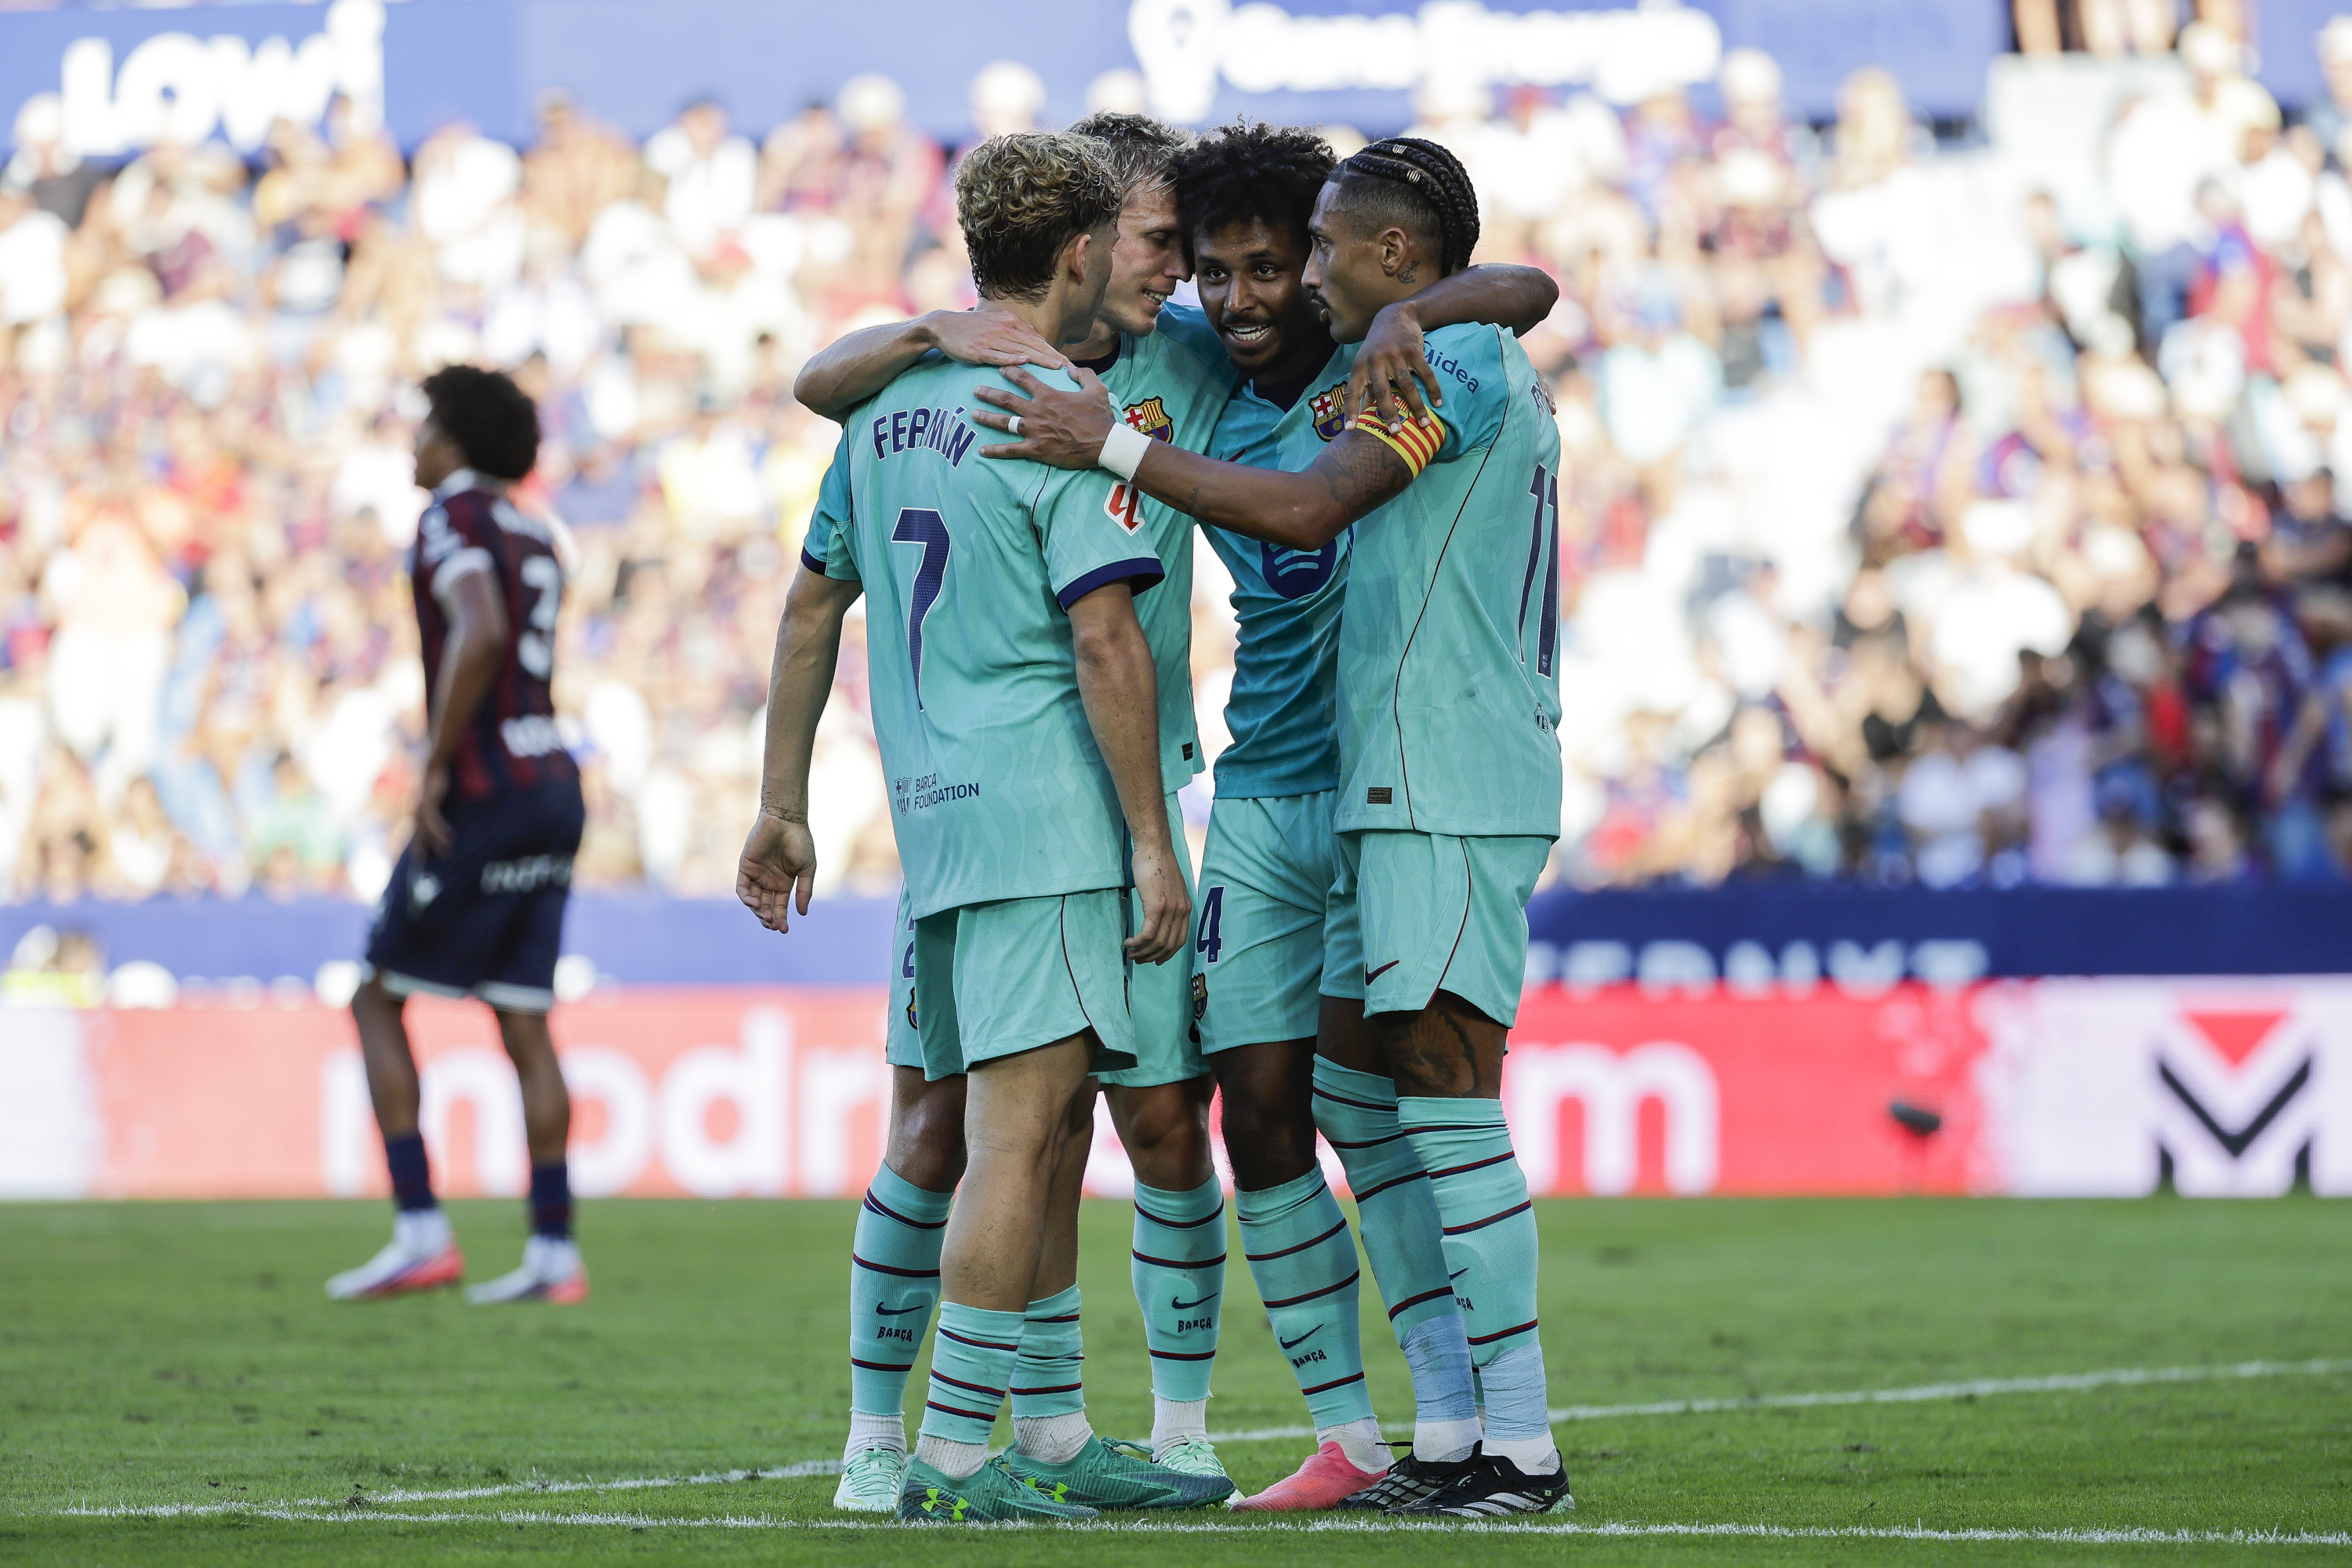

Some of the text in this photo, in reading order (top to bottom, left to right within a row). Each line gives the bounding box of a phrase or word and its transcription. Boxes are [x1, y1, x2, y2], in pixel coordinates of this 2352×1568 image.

[873, 405, 978, 470] FERMÍN
[1518, 461, 1559, 680] 11
[520, 553, 561, 679] 3
[890, 506, 952, 713] 7
[914, 782, 980, 811] FOUNDATION
[916, 773, 937, 793] BARÇA
[1196, 885, 1225, 964] 4
[1455, 1296, 1475, 1311] RÇA
[877, 1326, 913, 1342] BARÇA
[1178, 1317, 1212, 1333] BARÇA
[1292, 1348, 1327, 1369] BARÇA
